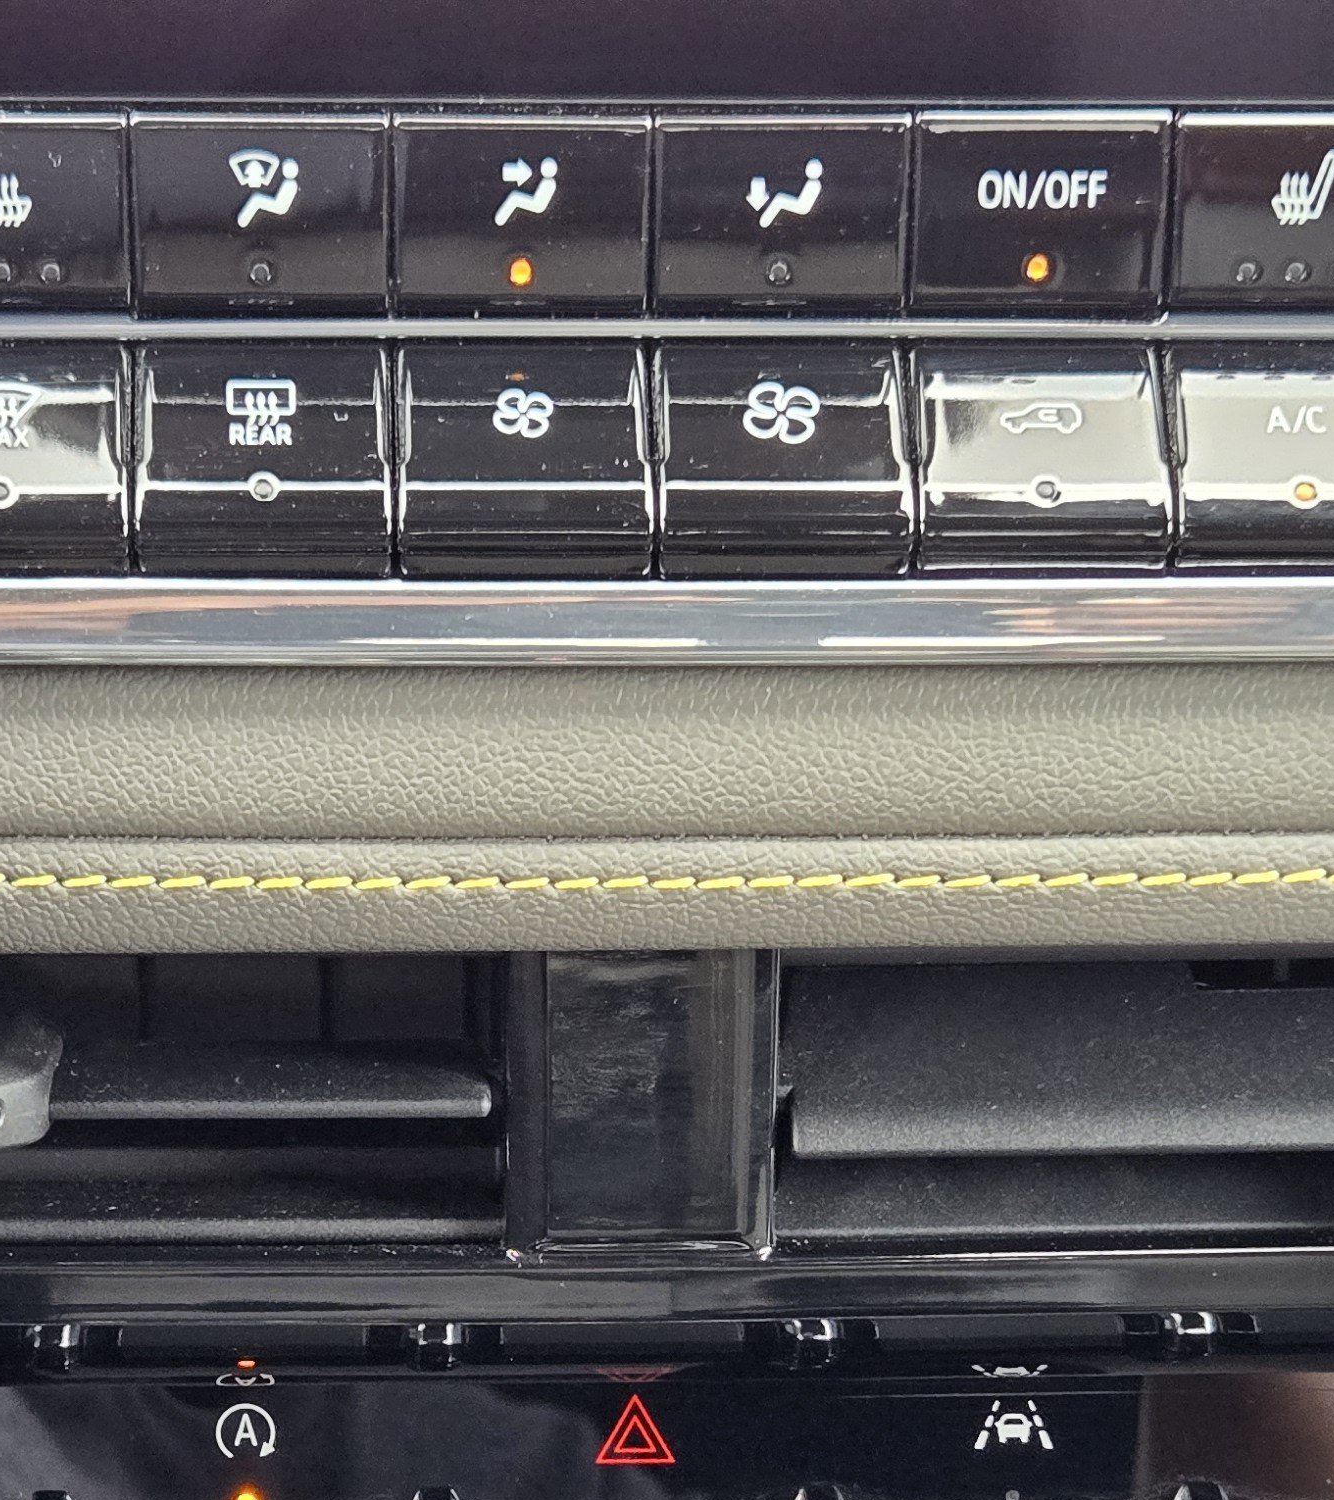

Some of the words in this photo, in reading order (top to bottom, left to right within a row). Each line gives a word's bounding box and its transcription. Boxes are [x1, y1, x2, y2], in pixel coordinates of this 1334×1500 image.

[977, 169, 1106, 209] ON/OFF
[1266, 405, 1327, 434] A/C
[227, 423, 293, 446] REAR
